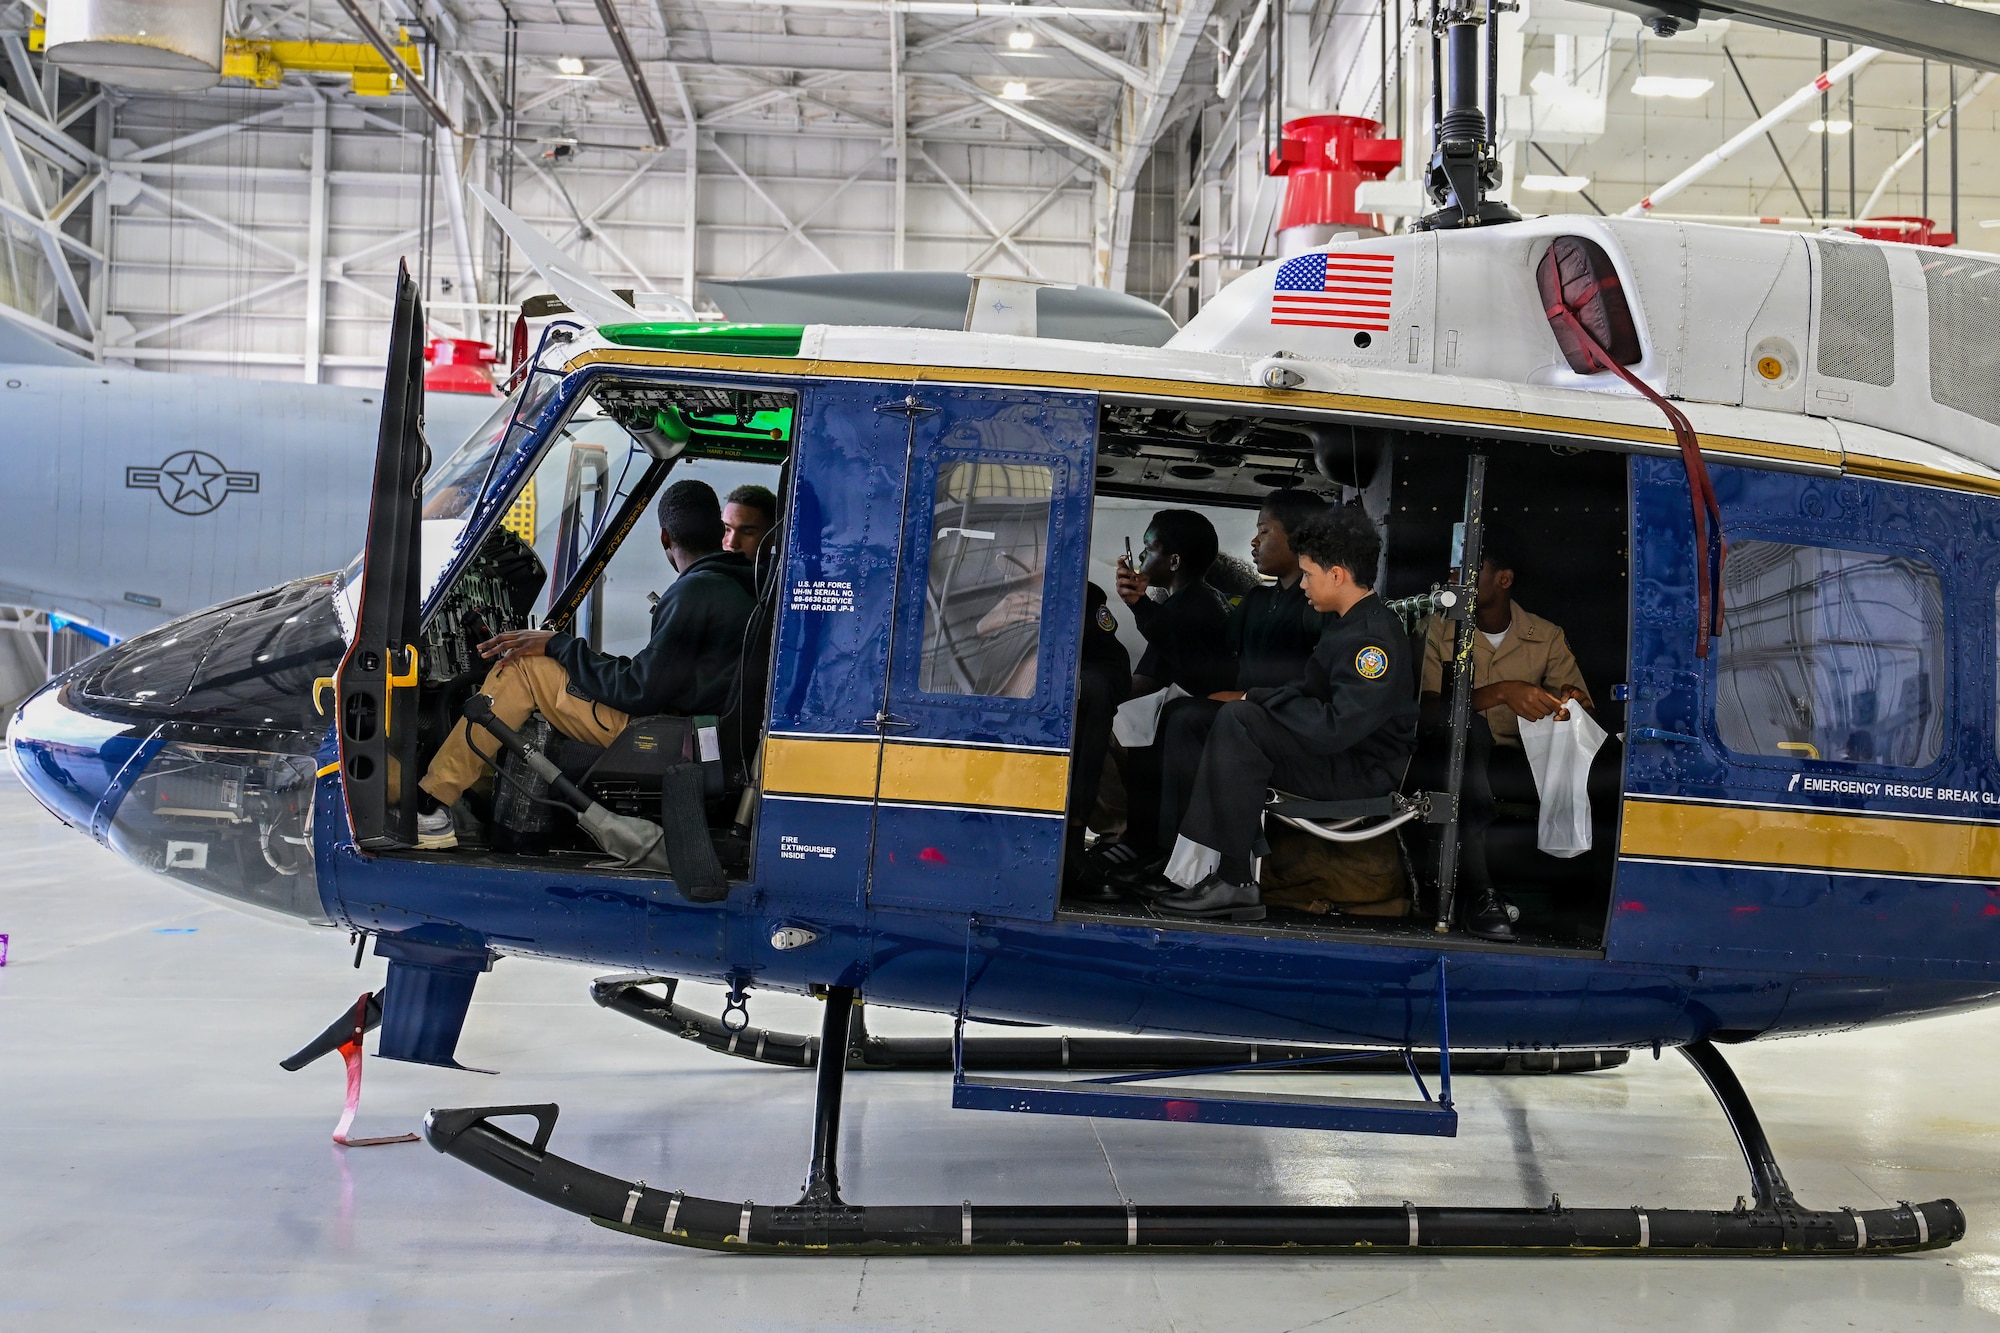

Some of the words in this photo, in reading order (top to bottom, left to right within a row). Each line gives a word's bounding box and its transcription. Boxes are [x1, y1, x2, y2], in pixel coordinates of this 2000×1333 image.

[607, 496, 649, 555] EMERGENCY
[570, 561, 605, 608] RELEASE
[797, 580, 811, 588] U.S.
[792, 588, 812, 596] UH-1N
[814, 589, 840, 597] SERIAL
[822, 597, 853, 605] SERVICE
[790, 603, 809, 611] WITH
[810, 604, 837, 612] GRADE
[838, 605, 855, 613] JP-8
[1803, 777, 1881, 795] EMERGENCY
[1884, 783, 1934, 799] RESCUE
[1937, 788, 1979, 803] BREAK
[781, 835, 799, 844] FIRE
[781, 844, 837, 855] EXTINGUISHER
[780, 851, 806, 860] INSIDE
